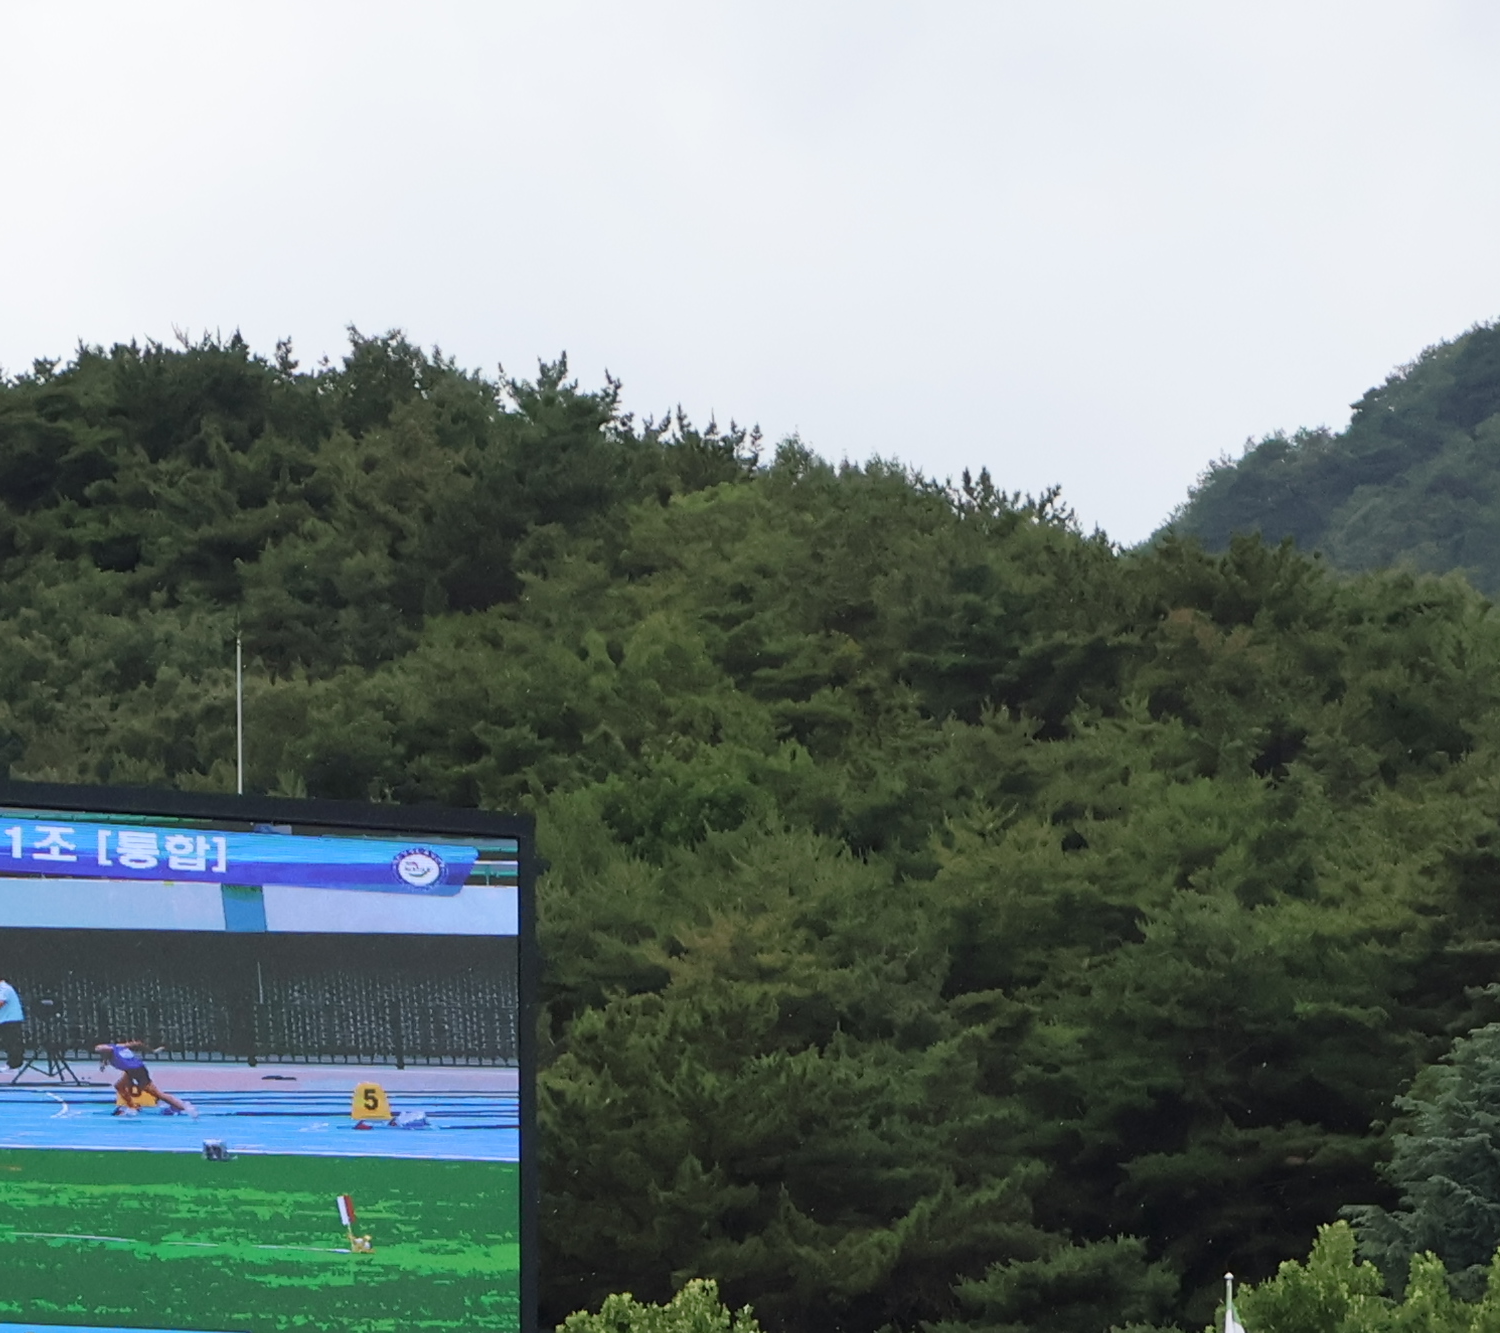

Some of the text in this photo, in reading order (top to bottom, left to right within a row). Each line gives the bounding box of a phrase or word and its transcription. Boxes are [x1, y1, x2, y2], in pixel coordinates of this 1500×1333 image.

[5, 826, 78, 862] 1조
[98, 829, 228, 873] [통합]
[364, 1089, 378, 1110] 5
